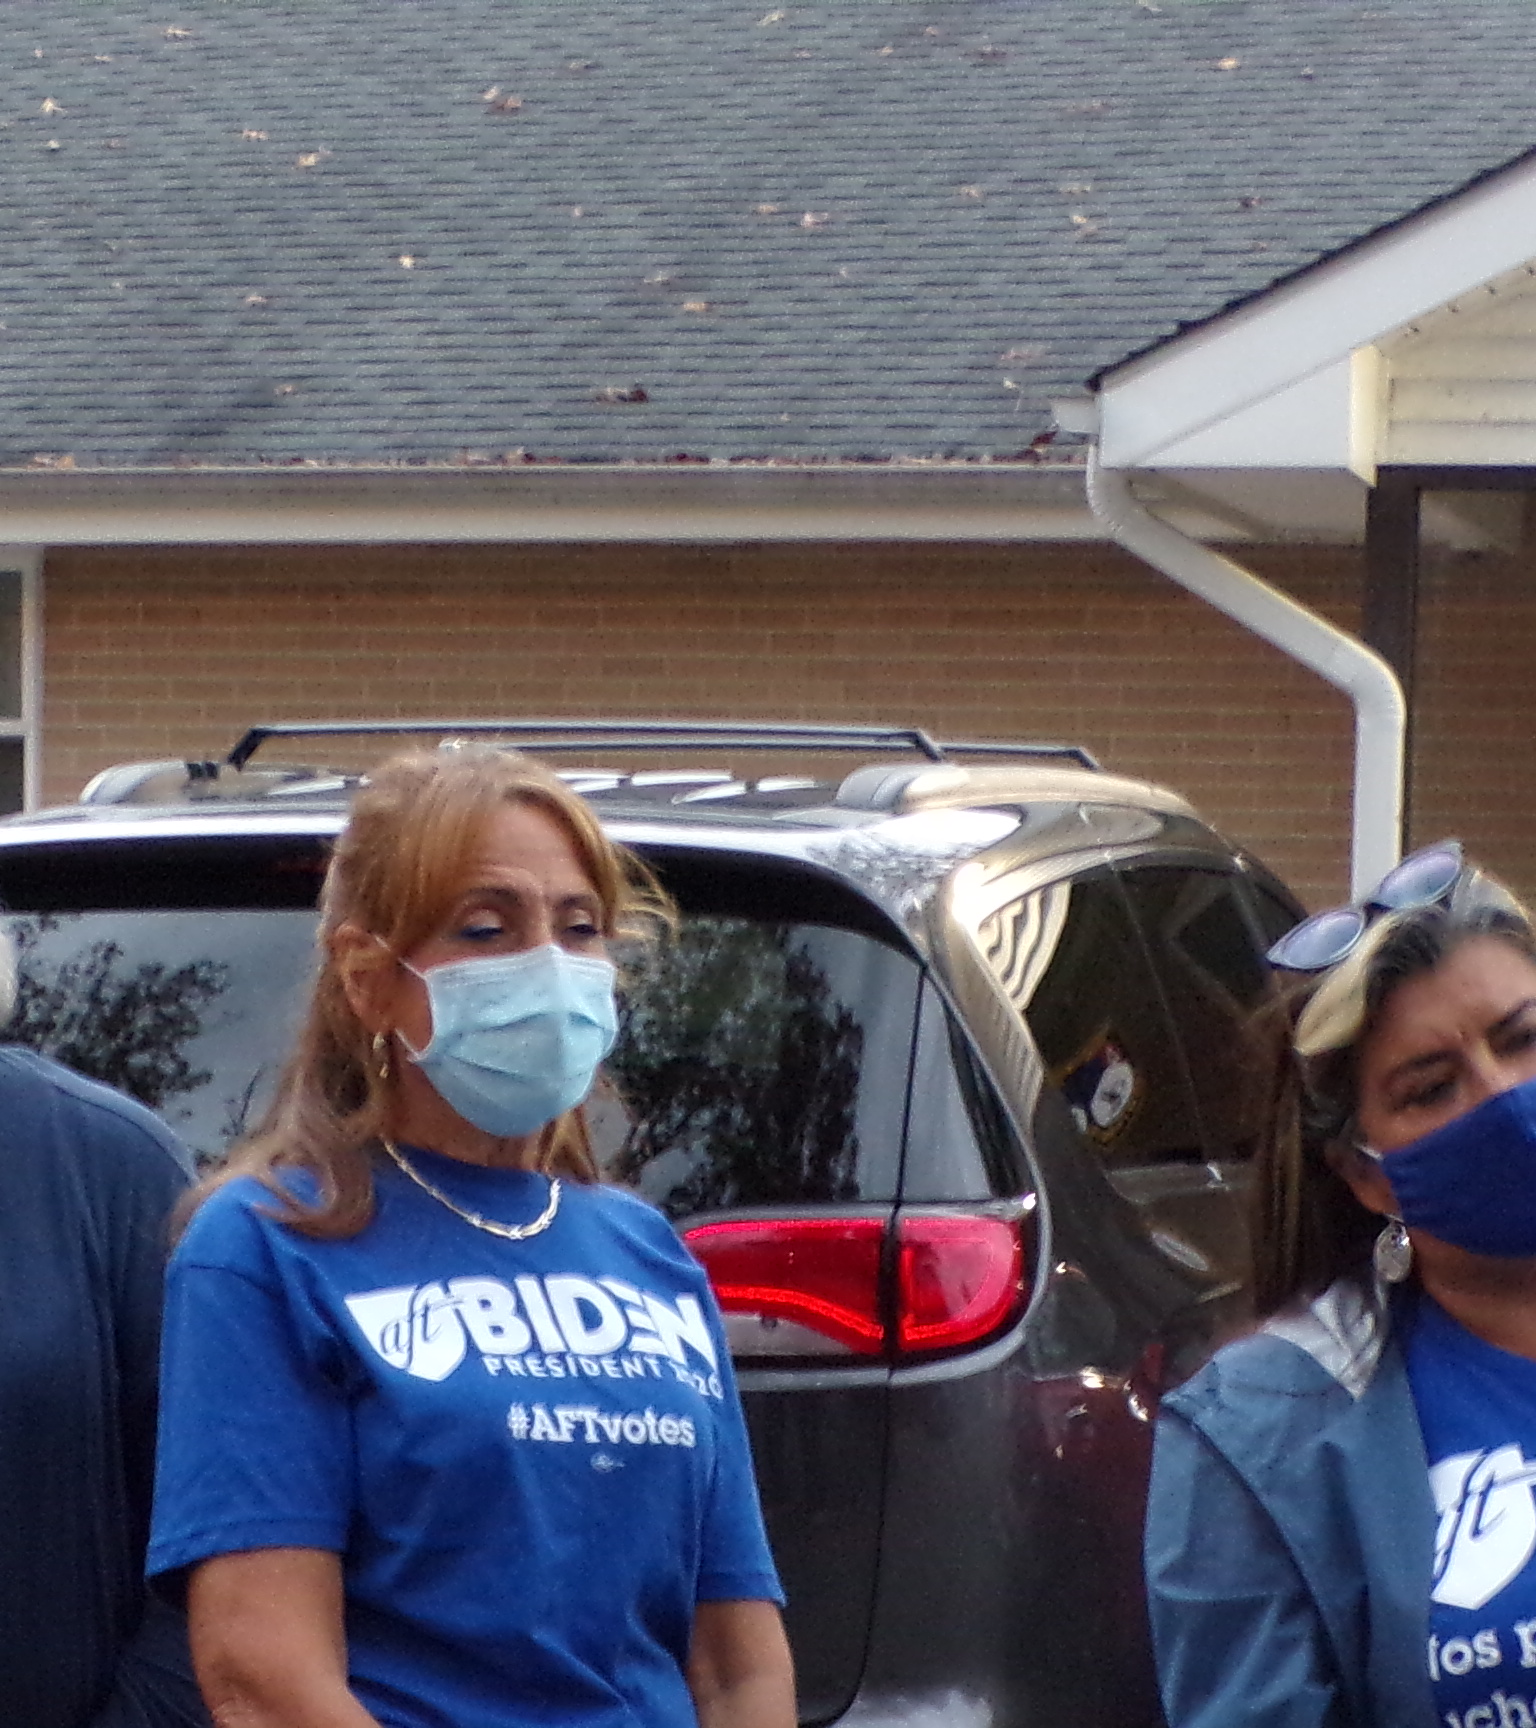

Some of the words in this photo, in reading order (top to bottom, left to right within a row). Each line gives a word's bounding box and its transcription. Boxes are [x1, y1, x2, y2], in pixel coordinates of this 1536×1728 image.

[449, 1273, 718, 1371] BIDEN
[482, 1353, 662, 1380] PRESIDENT
[507, 1402, 697, 1449] #AFTvotes
